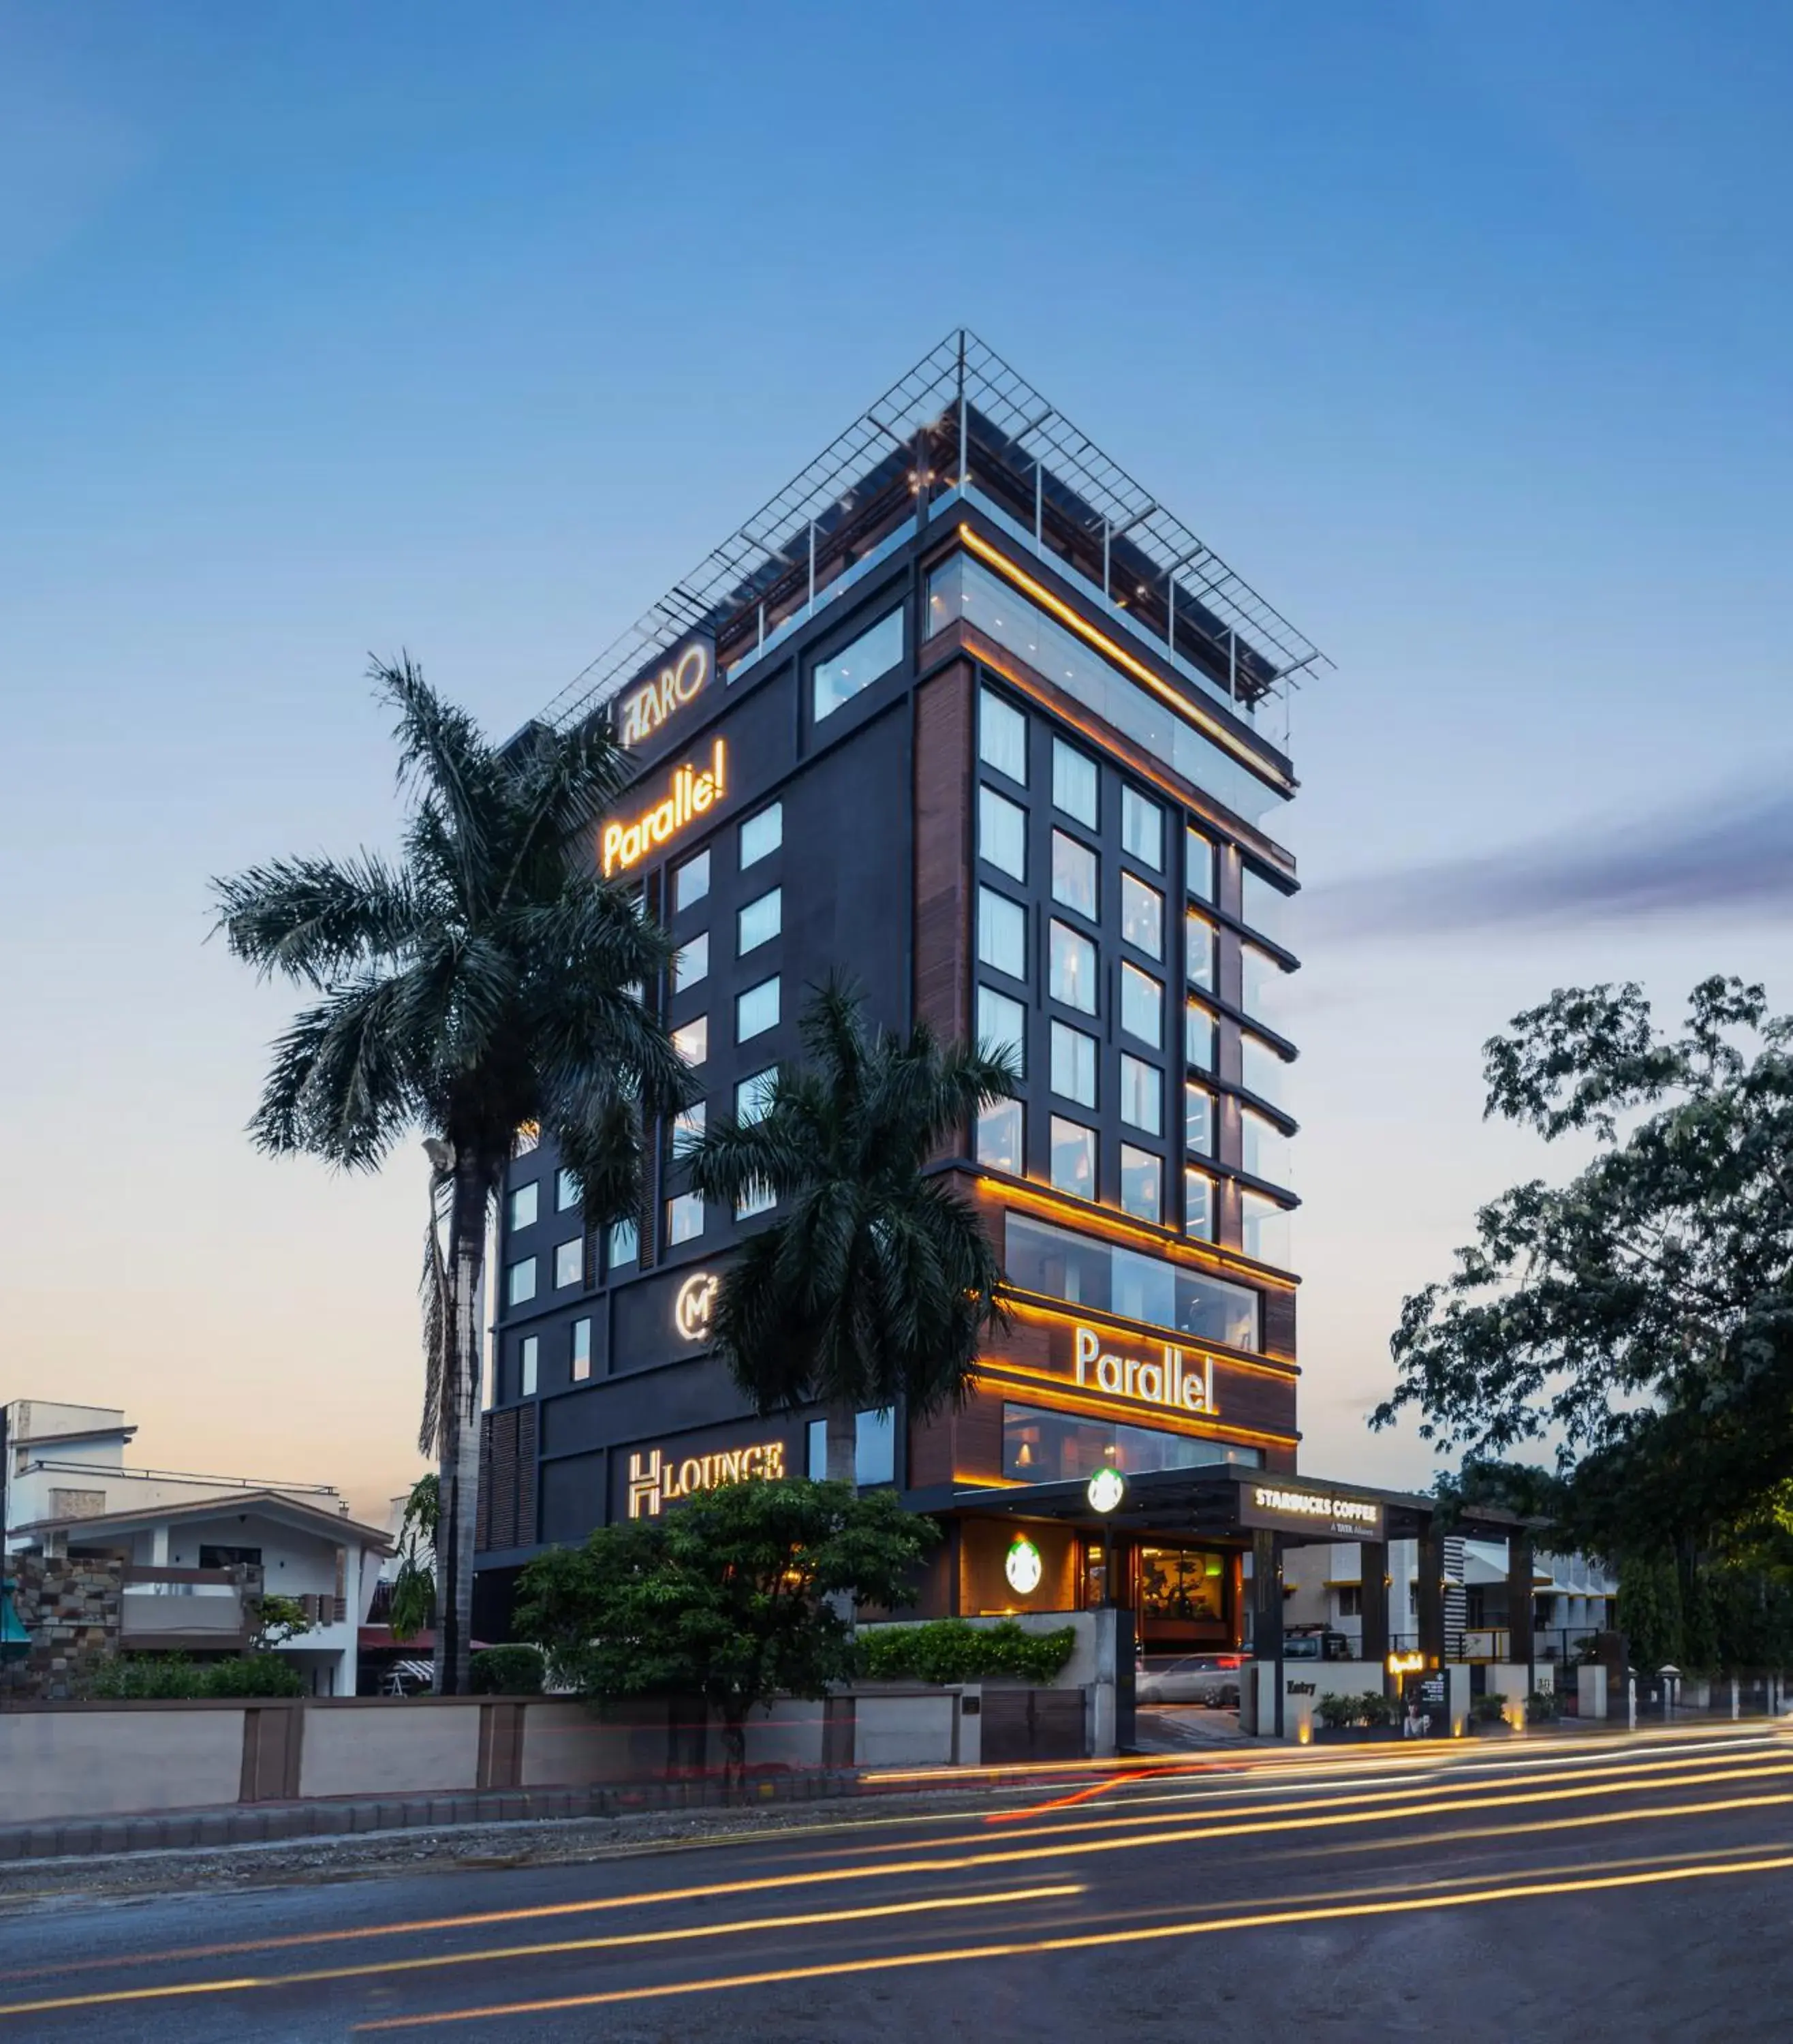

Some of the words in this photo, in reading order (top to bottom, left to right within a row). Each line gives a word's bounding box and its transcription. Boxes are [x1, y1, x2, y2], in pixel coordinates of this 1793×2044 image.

[604, 738, 725, 878] Parallel
[1076, 1326, 1214, 1414] Parallel
[661, 1441, 783, 1498] LOUNGE
[1256, 1487, 1332, 1515] STARBUCKS
[1332, 1500, 1377, 1523] COFFEE
